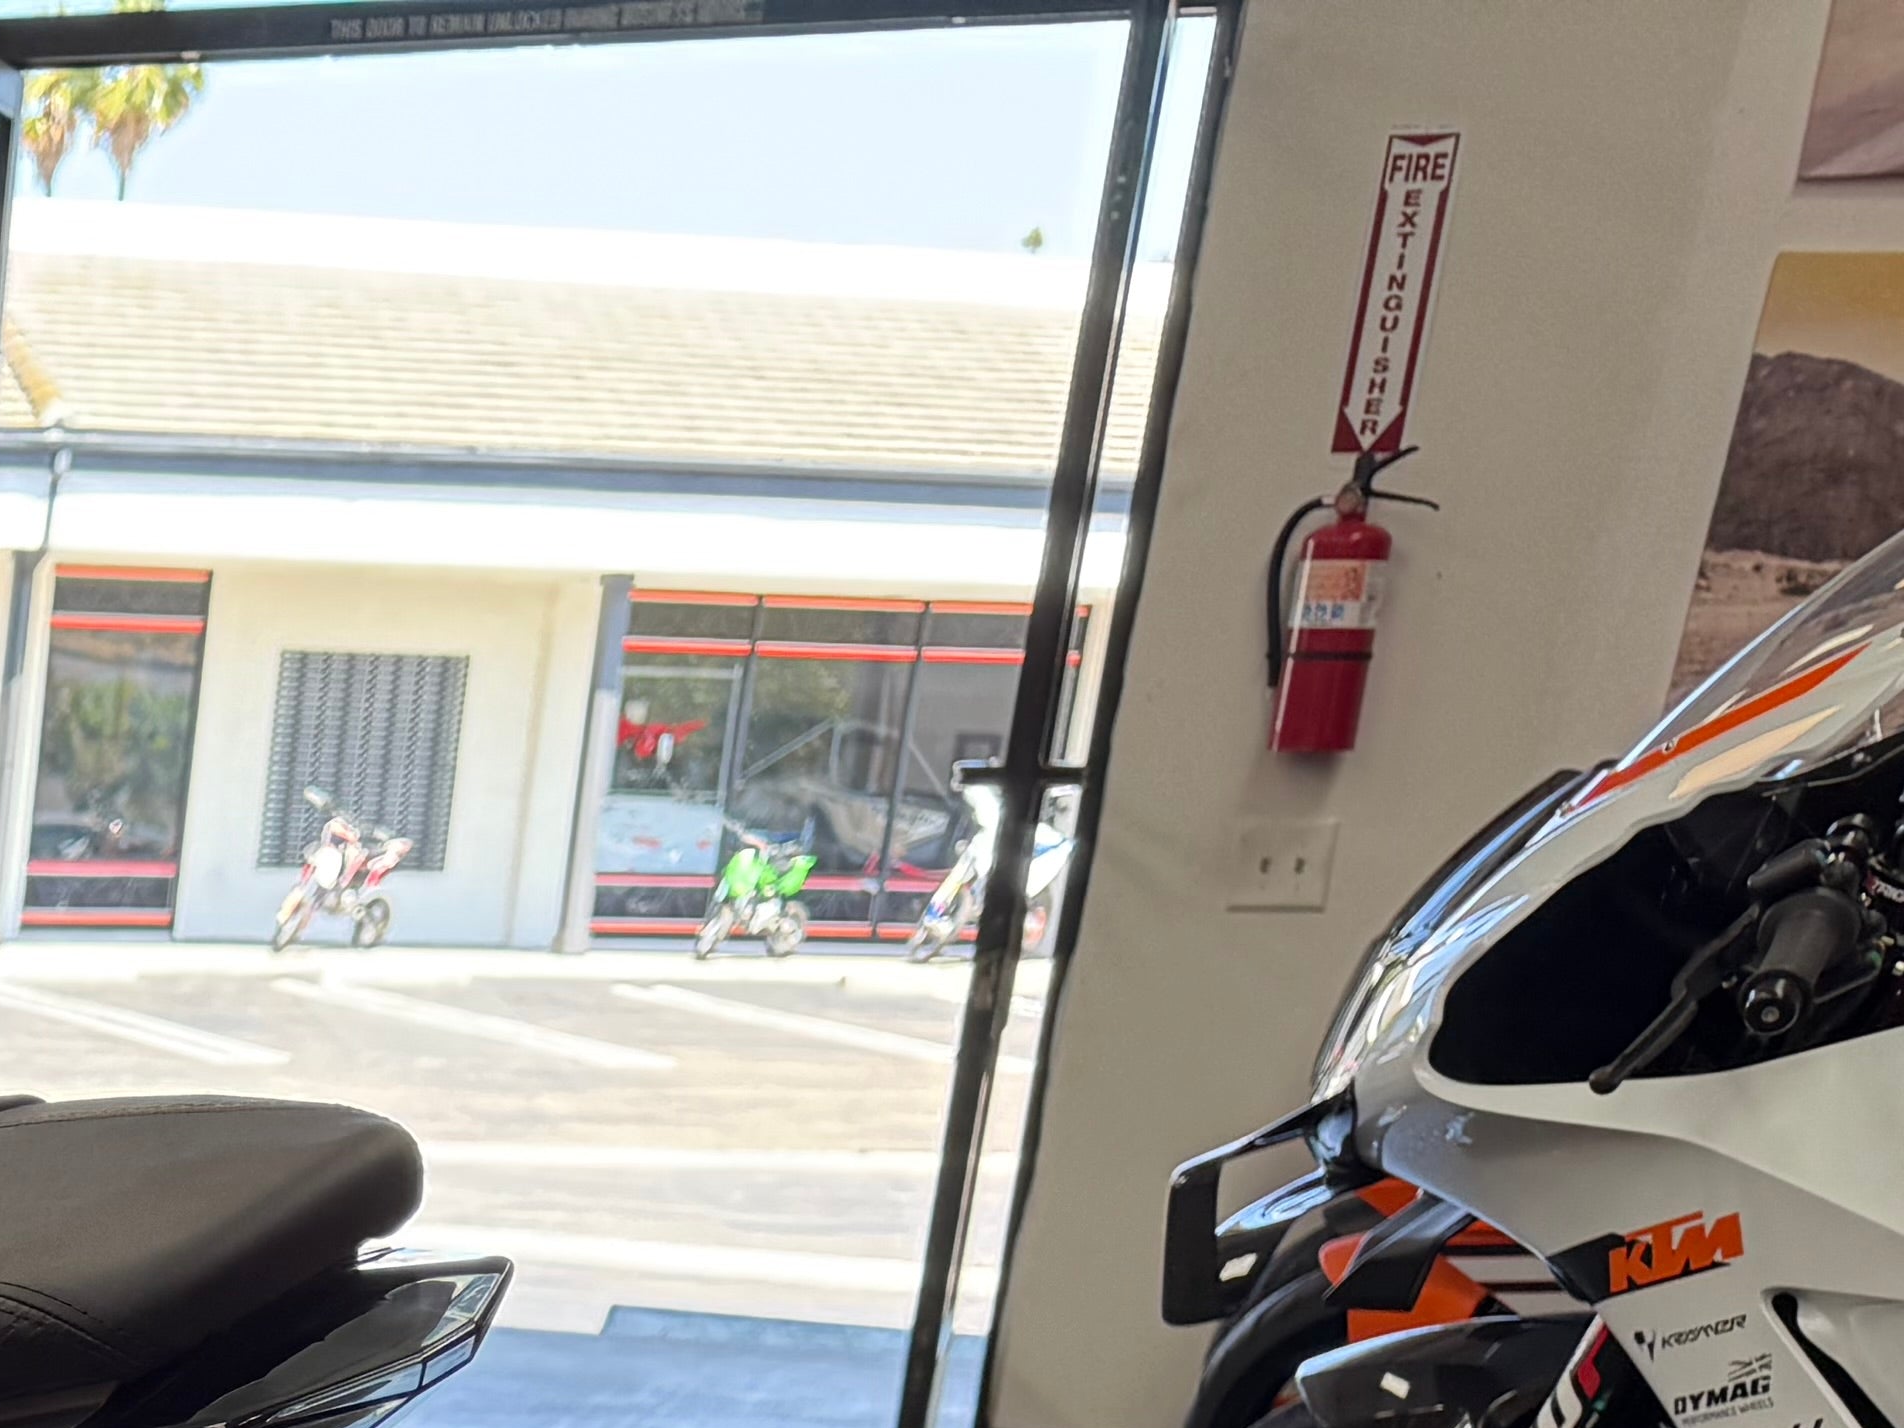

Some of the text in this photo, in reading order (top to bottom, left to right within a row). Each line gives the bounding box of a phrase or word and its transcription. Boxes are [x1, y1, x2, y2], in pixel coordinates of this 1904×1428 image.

[1389, 152, 1449, 183] FIRE
[1359, 189, 1424, 436] EXTINGUISHER
[1608, 1210, 1744, 1294] KTM
[1674, 1375, 1772, 1416] DYMAG
